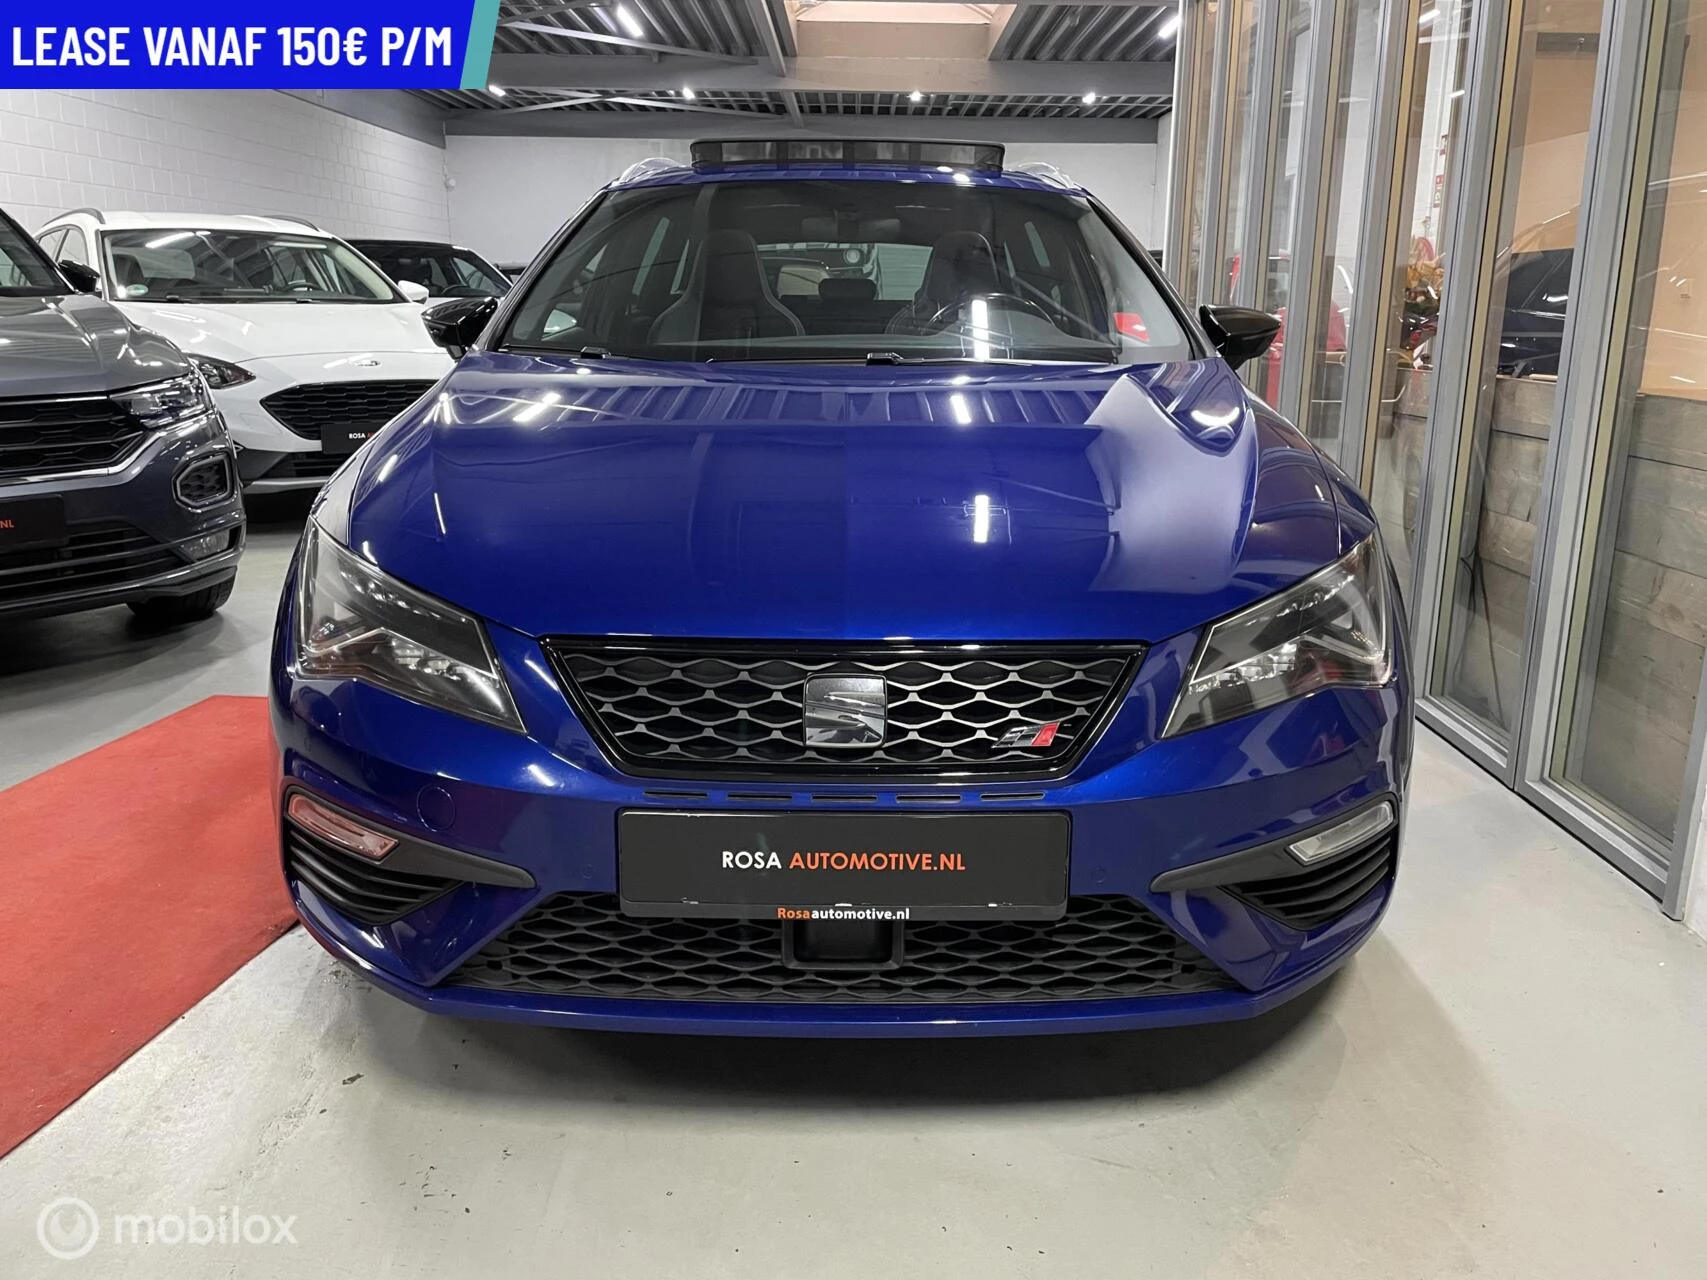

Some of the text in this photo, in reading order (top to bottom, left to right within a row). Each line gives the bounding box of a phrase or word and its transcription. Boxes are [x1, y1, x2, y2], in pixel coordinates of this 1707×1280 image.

[348, 432, 366, 440] ROSA
[722, 851, 966, 871] ROSA AUTOMOTIVE.NL
[777, 907, 911, 920] Rosaautomotive.nl
